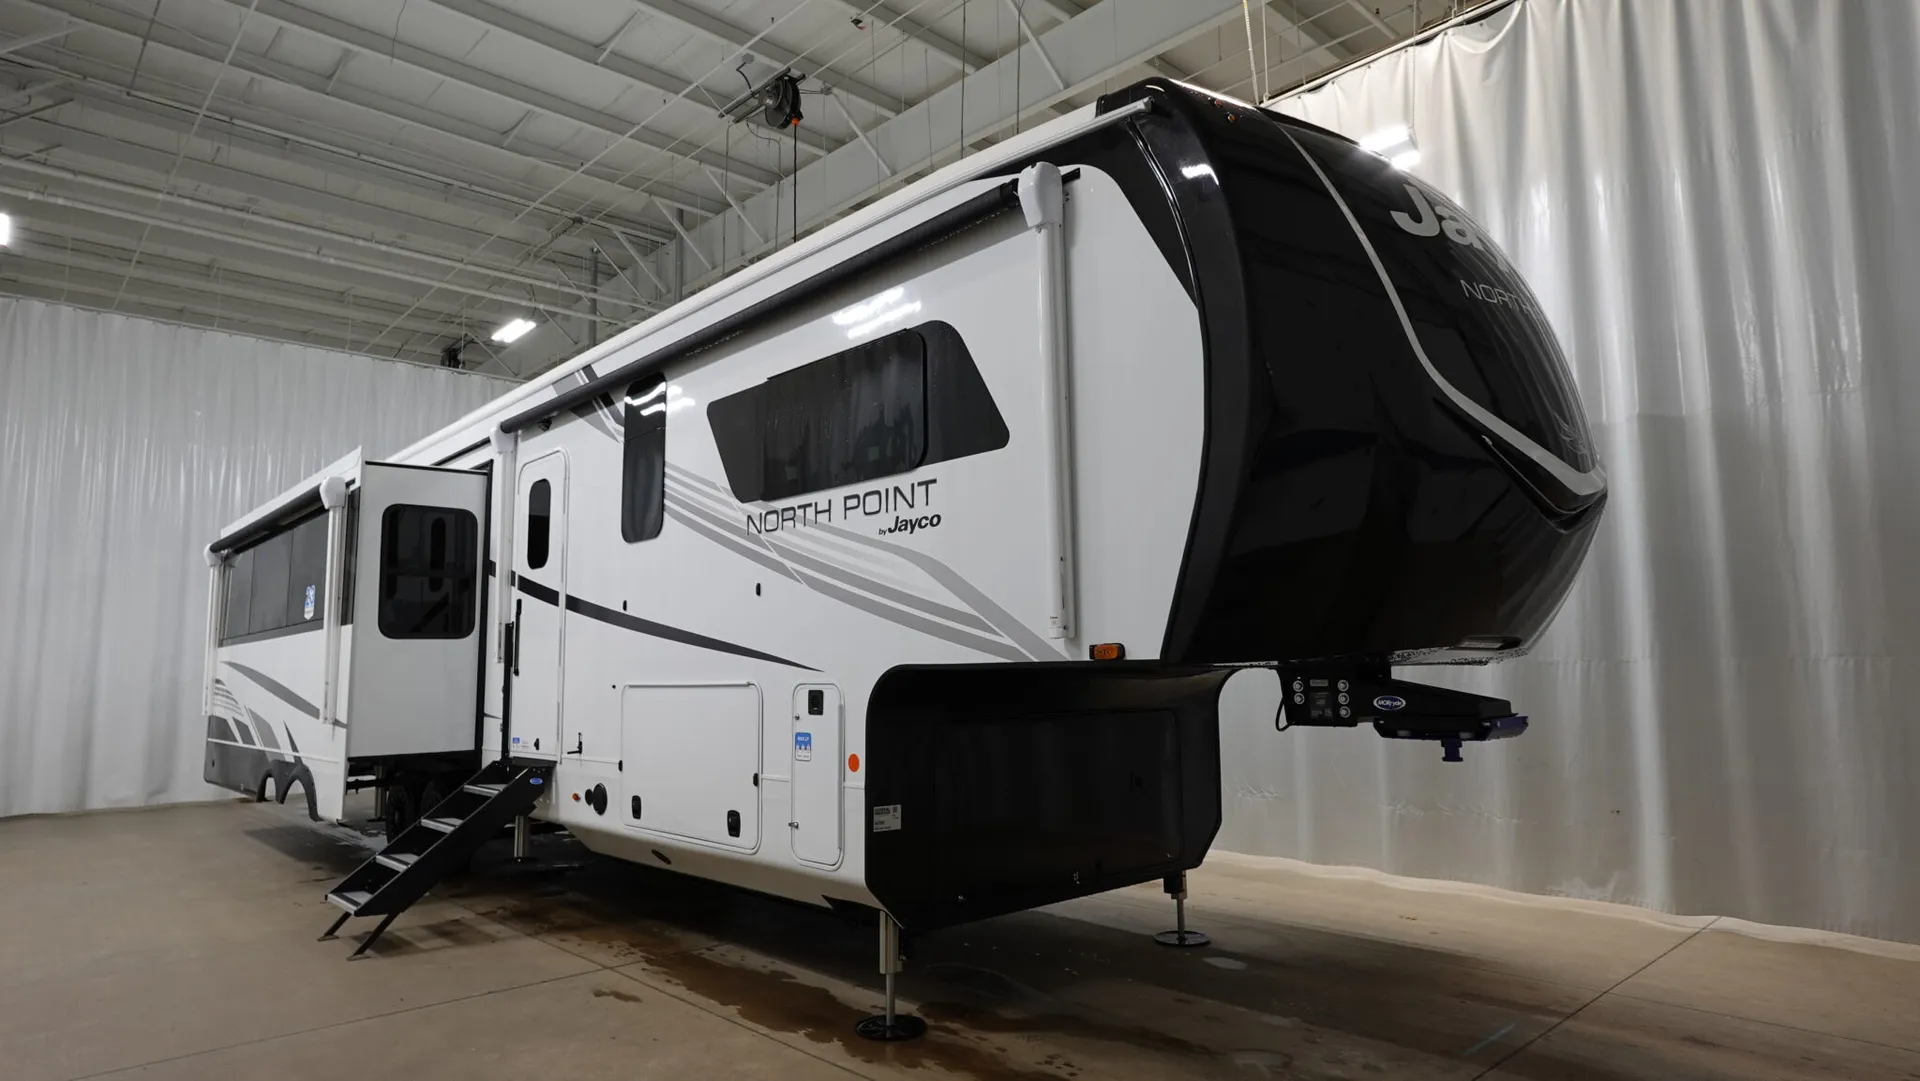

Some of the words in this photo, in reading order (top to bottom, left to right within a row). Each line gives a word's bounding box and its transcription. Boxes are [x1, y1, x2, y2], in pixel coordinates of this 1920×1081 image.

[746, 498, 832, 536] NORTH
[843, 478, 938, 520] POINT
[878, 527, 888, 536] by
[887, 513, 942, 535] Jayco
